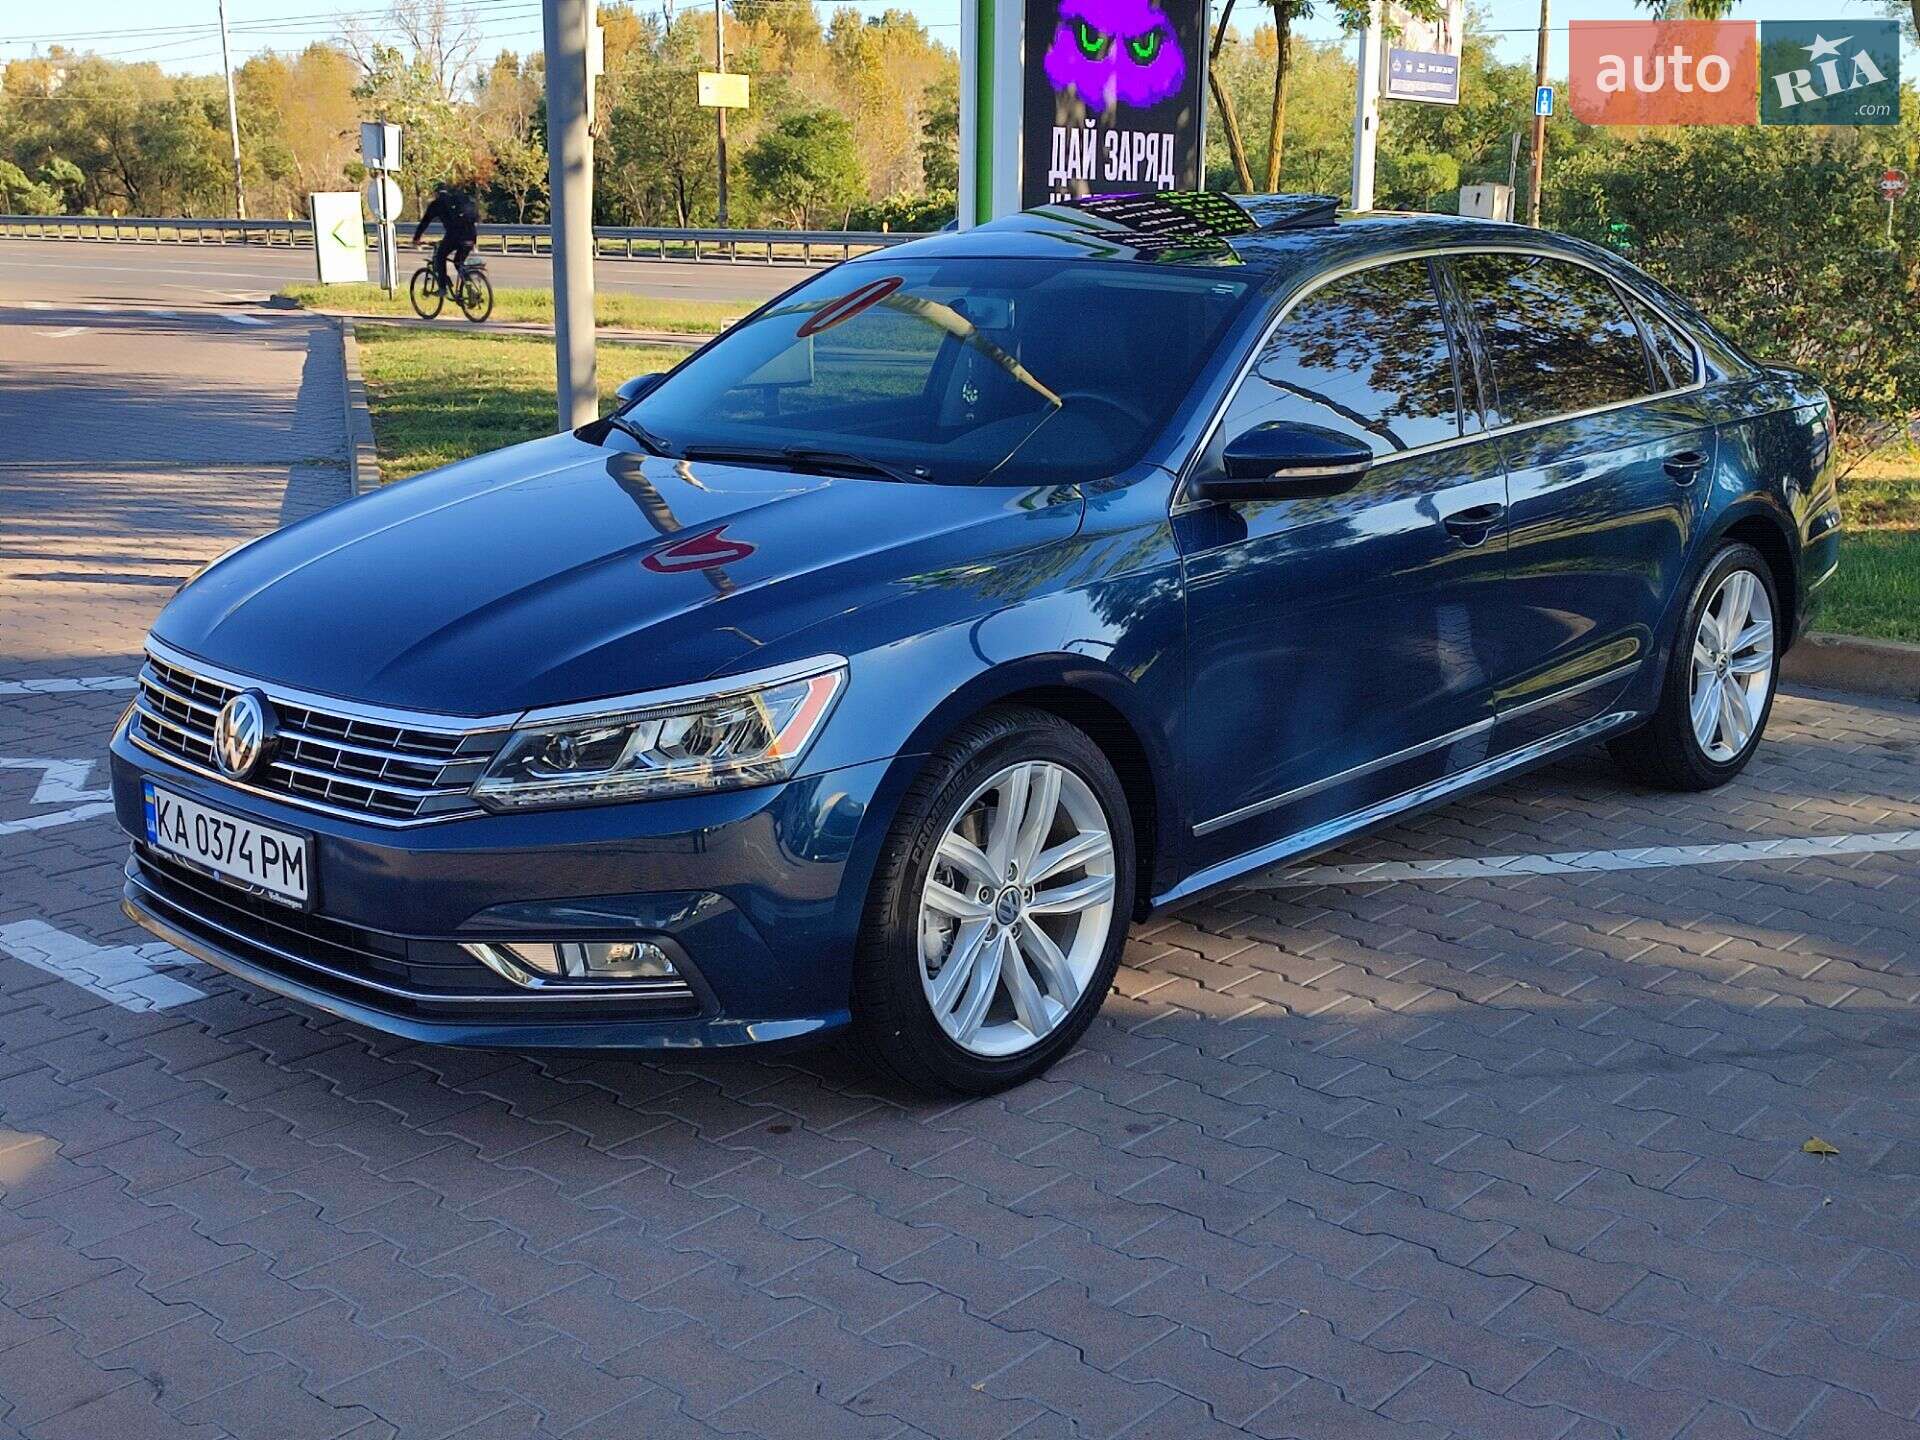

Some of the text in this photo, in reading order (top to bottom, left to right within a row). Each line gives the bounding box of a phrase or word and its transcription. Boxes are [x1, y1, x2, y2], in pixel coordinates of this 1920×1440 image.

[1048, 118, 1175, 190] ДАЙ ЗАРЯД
[156, 795, 304, 891] KA 0374 PM
